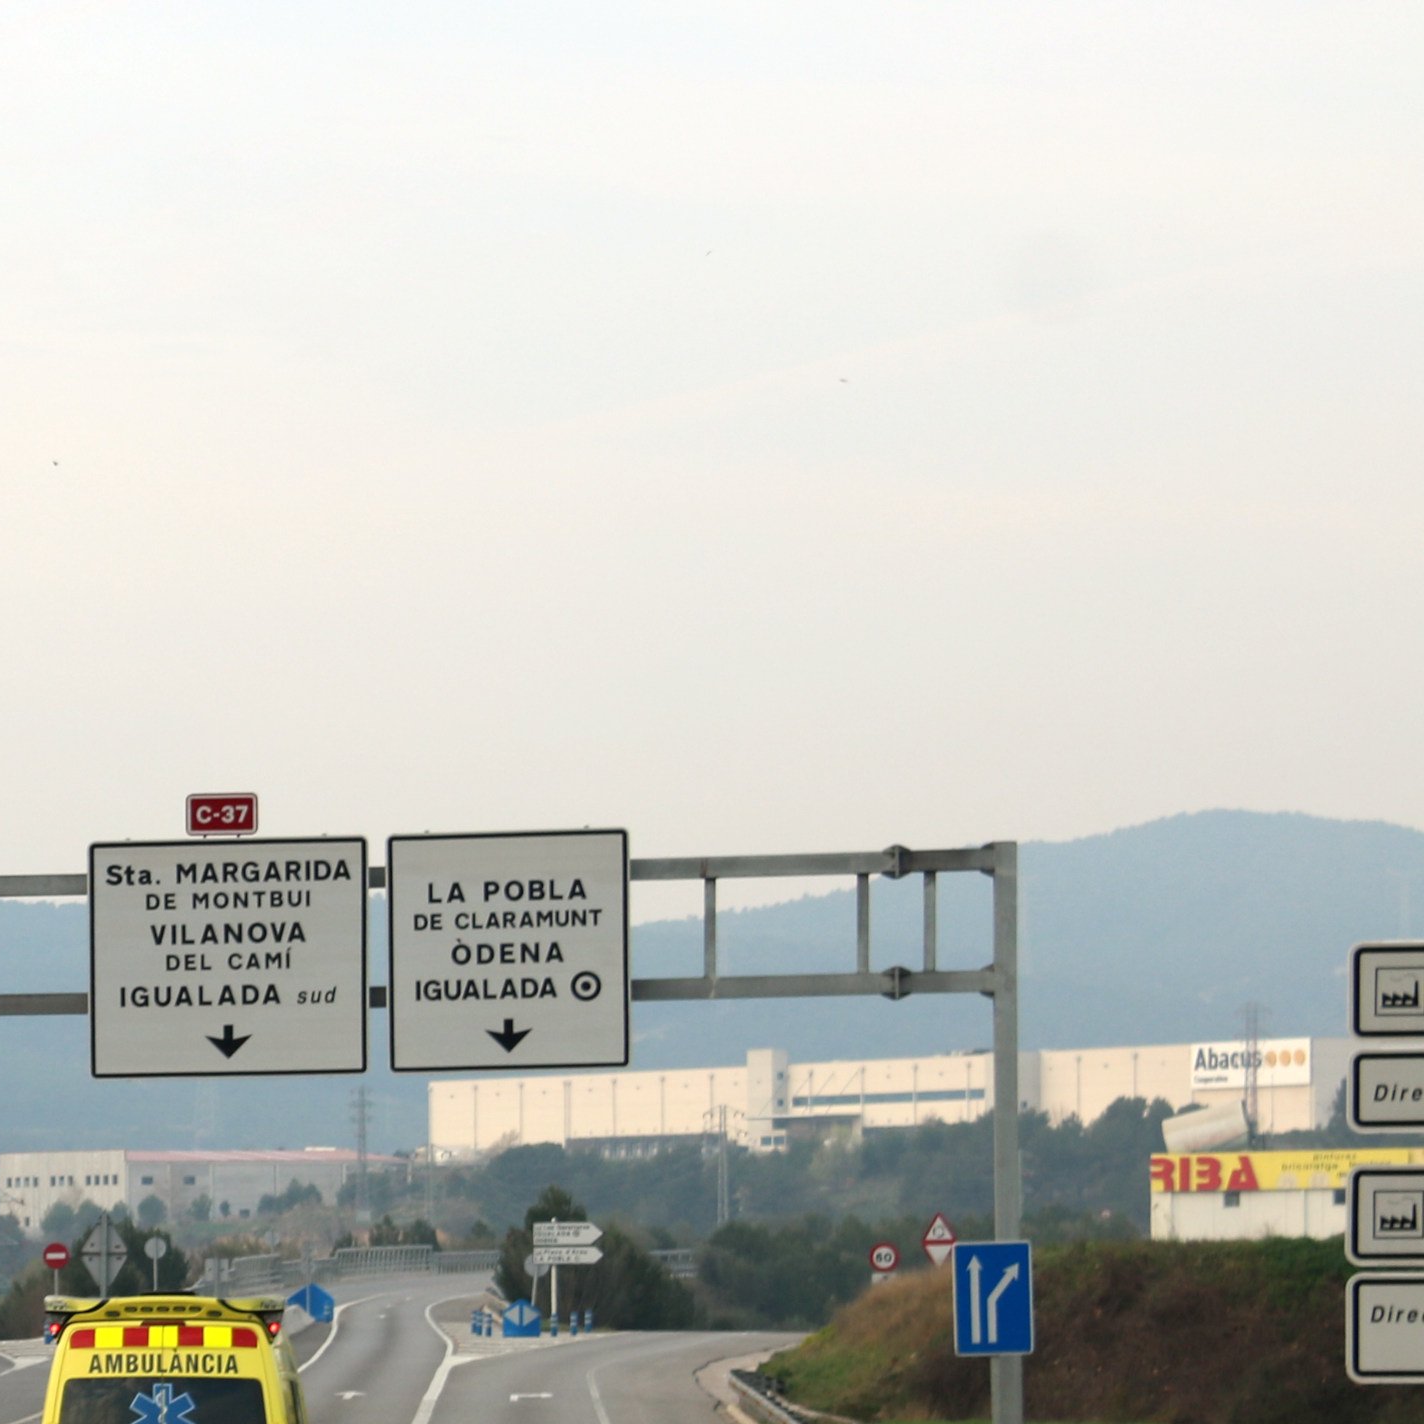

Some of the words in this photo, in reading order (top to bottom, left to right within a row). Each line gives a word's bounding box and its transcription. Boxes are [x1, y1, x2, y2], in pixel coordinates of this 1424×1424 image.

[196, 805, 249, 824] C-37
[106, 864, 161, 886] Sta.
[176, 859, 351, 884] MARGARIDA
[145, 893, 177, 911] DE
[192, 890, 311, 910] MONTBUI
[428, 882, 466, 904] LA
[483, 878, 587, 902] POBLA
[413, 913, 443, 931] DE
[454, 908, 602, 930] CLARAMUNT
[150, 921, 306, 946] VILANOVA
[166, 954, 212, 971] DEL
[227, 949, 291, 970] CAMÍ
[451, 939, 564, 965] ÒDENA
[120, 983, 281, 1008] IGUALADA
[297, 985, 337, 1005] sud
[415, 977, 557, 1001] IGUALADA
[1194, 1047, 1263, 1071] Abacus
[1150, 1156, 1260, 1192] RIBA
[1370, 1304, 1424, 1323] Dire
[88, 1349, 239, 1374] AMBULÀNCIA
